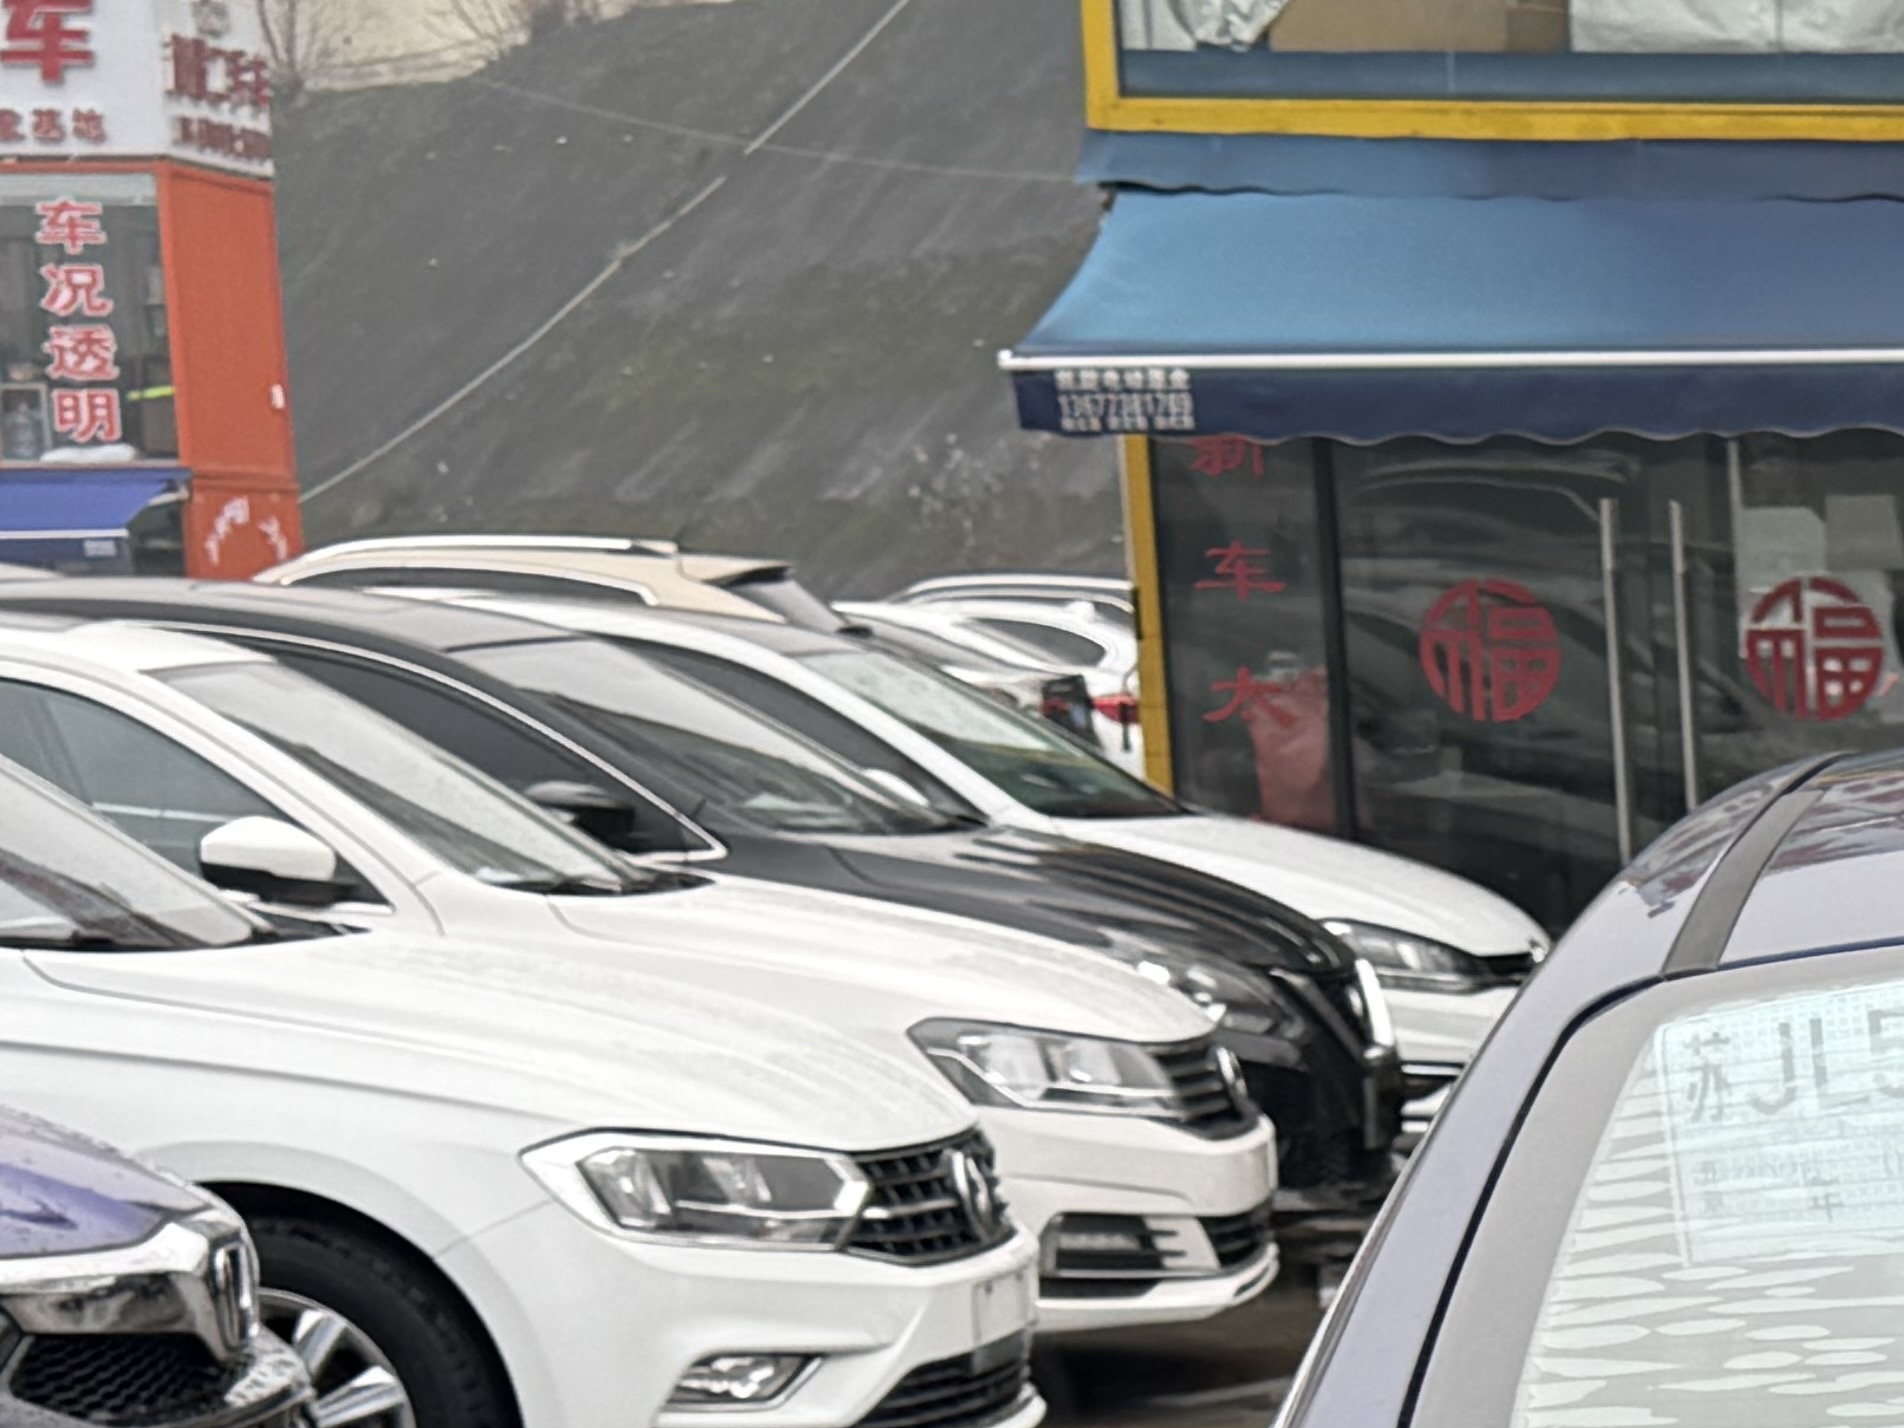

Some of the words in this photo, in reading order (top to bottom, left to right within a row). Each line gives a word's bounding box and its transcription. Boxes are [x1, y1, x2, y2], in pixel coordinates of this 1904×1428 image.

[36, 194, 121, 444] 车况透明
[1420, 578, 1562, 721] 福
[1746, 576, 1884, 721] 福
